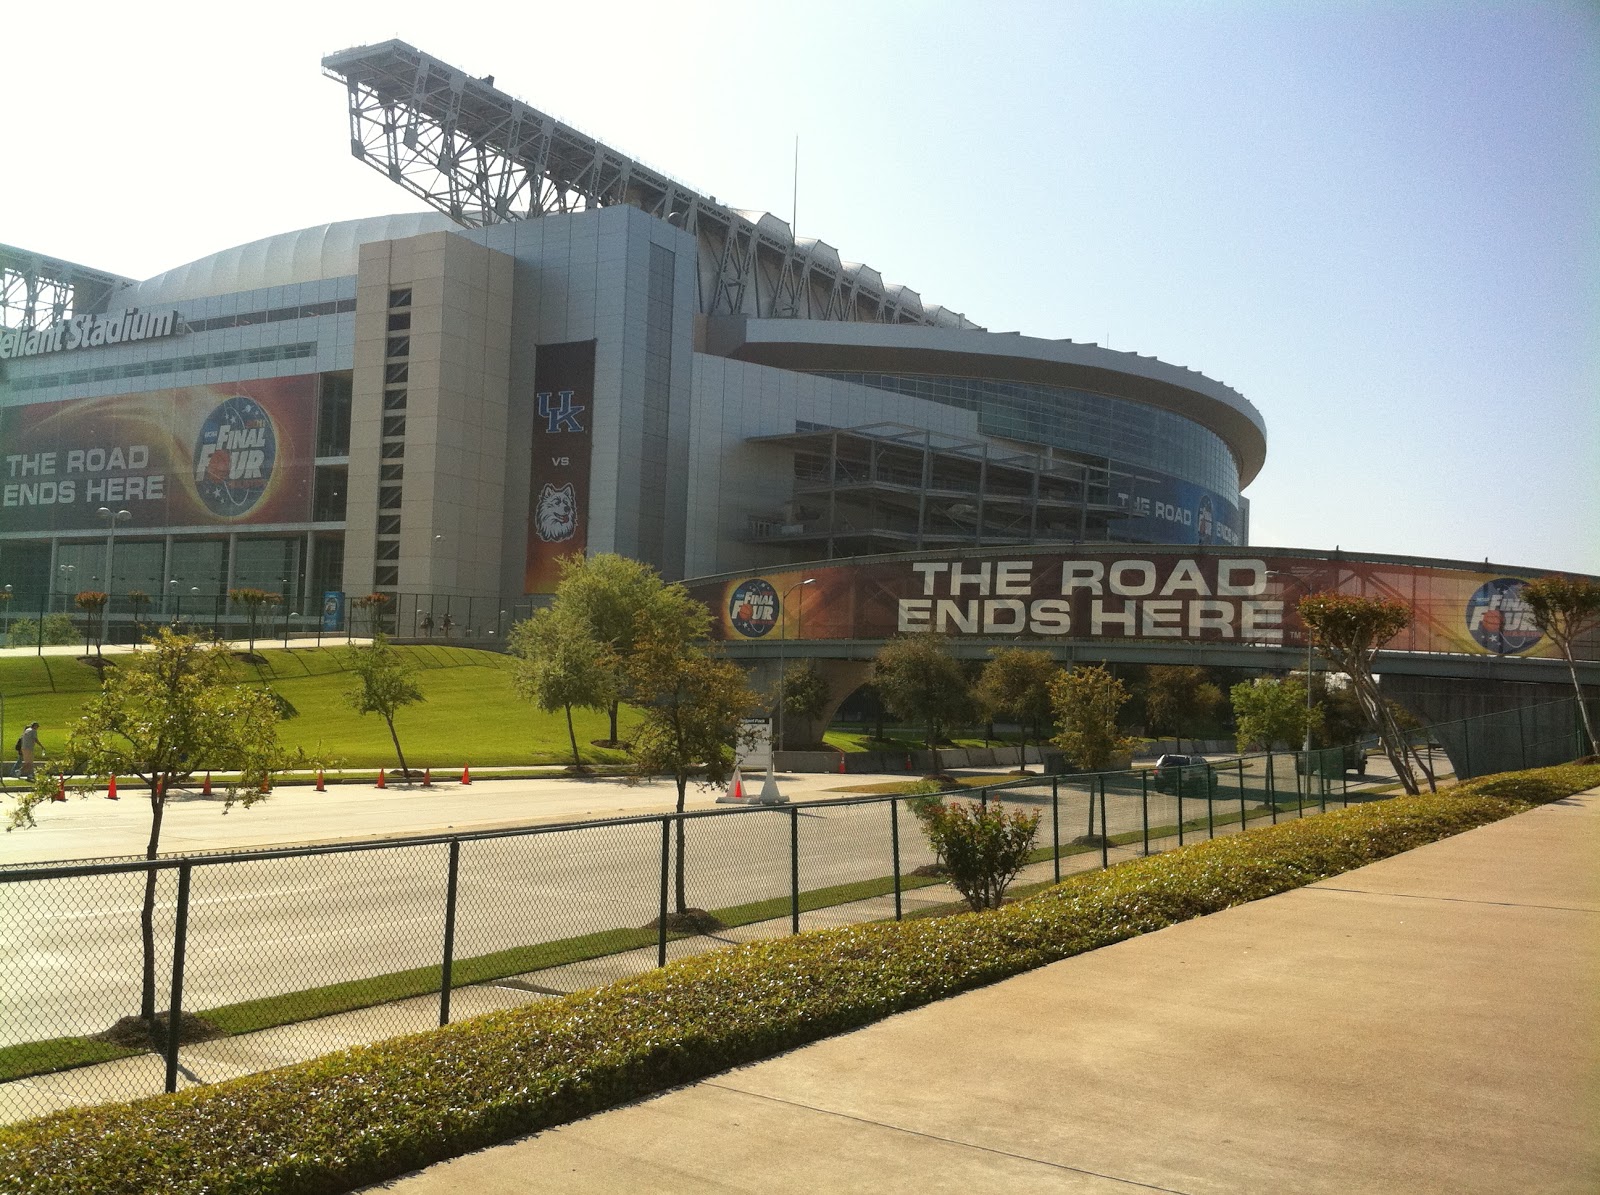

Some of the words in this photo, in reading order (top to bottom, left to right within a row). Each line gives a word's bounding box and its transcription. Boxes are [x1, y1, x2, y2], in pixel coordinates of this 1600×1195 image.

[0, 318, 65, 359] eliant
[67, 307, 175, 350] Stadium
[536, 390, 585, 433] UK
[215, 424, 266, 451] FINAL
[6, 451, 57, 477] THE
[66, 445, 150, 473] ROAD
[3, 480, 76, 507] ENDS
[85, 475, 165, 503] HERE
[1155, 501, 1192, 526] ROAD
[913, 560, 1034, 596] THE
[1061, 560, 1267, 597] ROAD
[744, 591, 774, 606] FINAL
[897, 599, 1071, 635] ENDS
[1090, 600, 1285, 640] HERE
